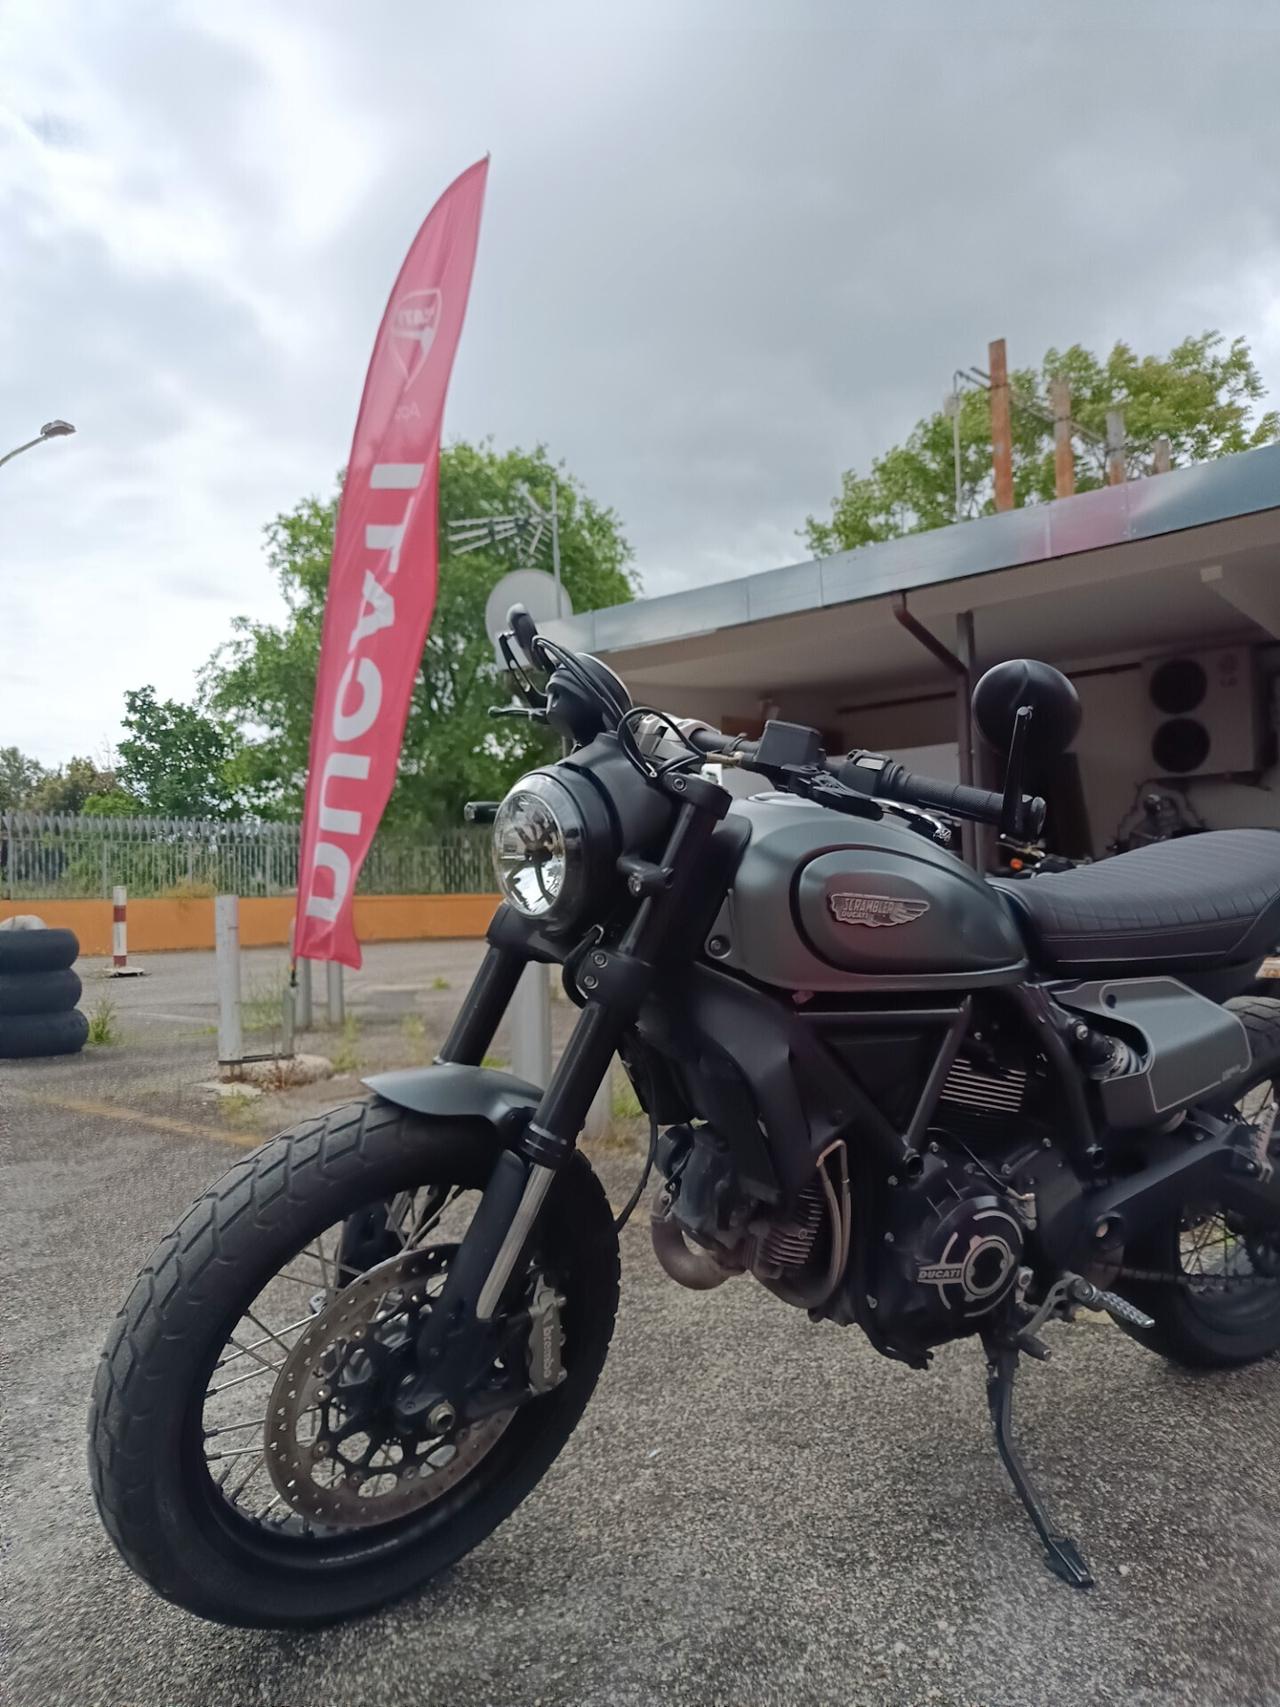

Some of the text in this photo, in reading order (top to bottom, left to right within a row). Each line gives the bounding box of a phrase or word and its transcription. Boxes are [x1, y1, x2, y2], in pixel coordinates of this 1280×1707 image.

[842, 898, 895, 914] SCRAMBLER
[841, 911, 869, 919] DUCATI
[918, 1269, 961, 1279] DUCATI
[543, 1324, 555, 1378] brembo
